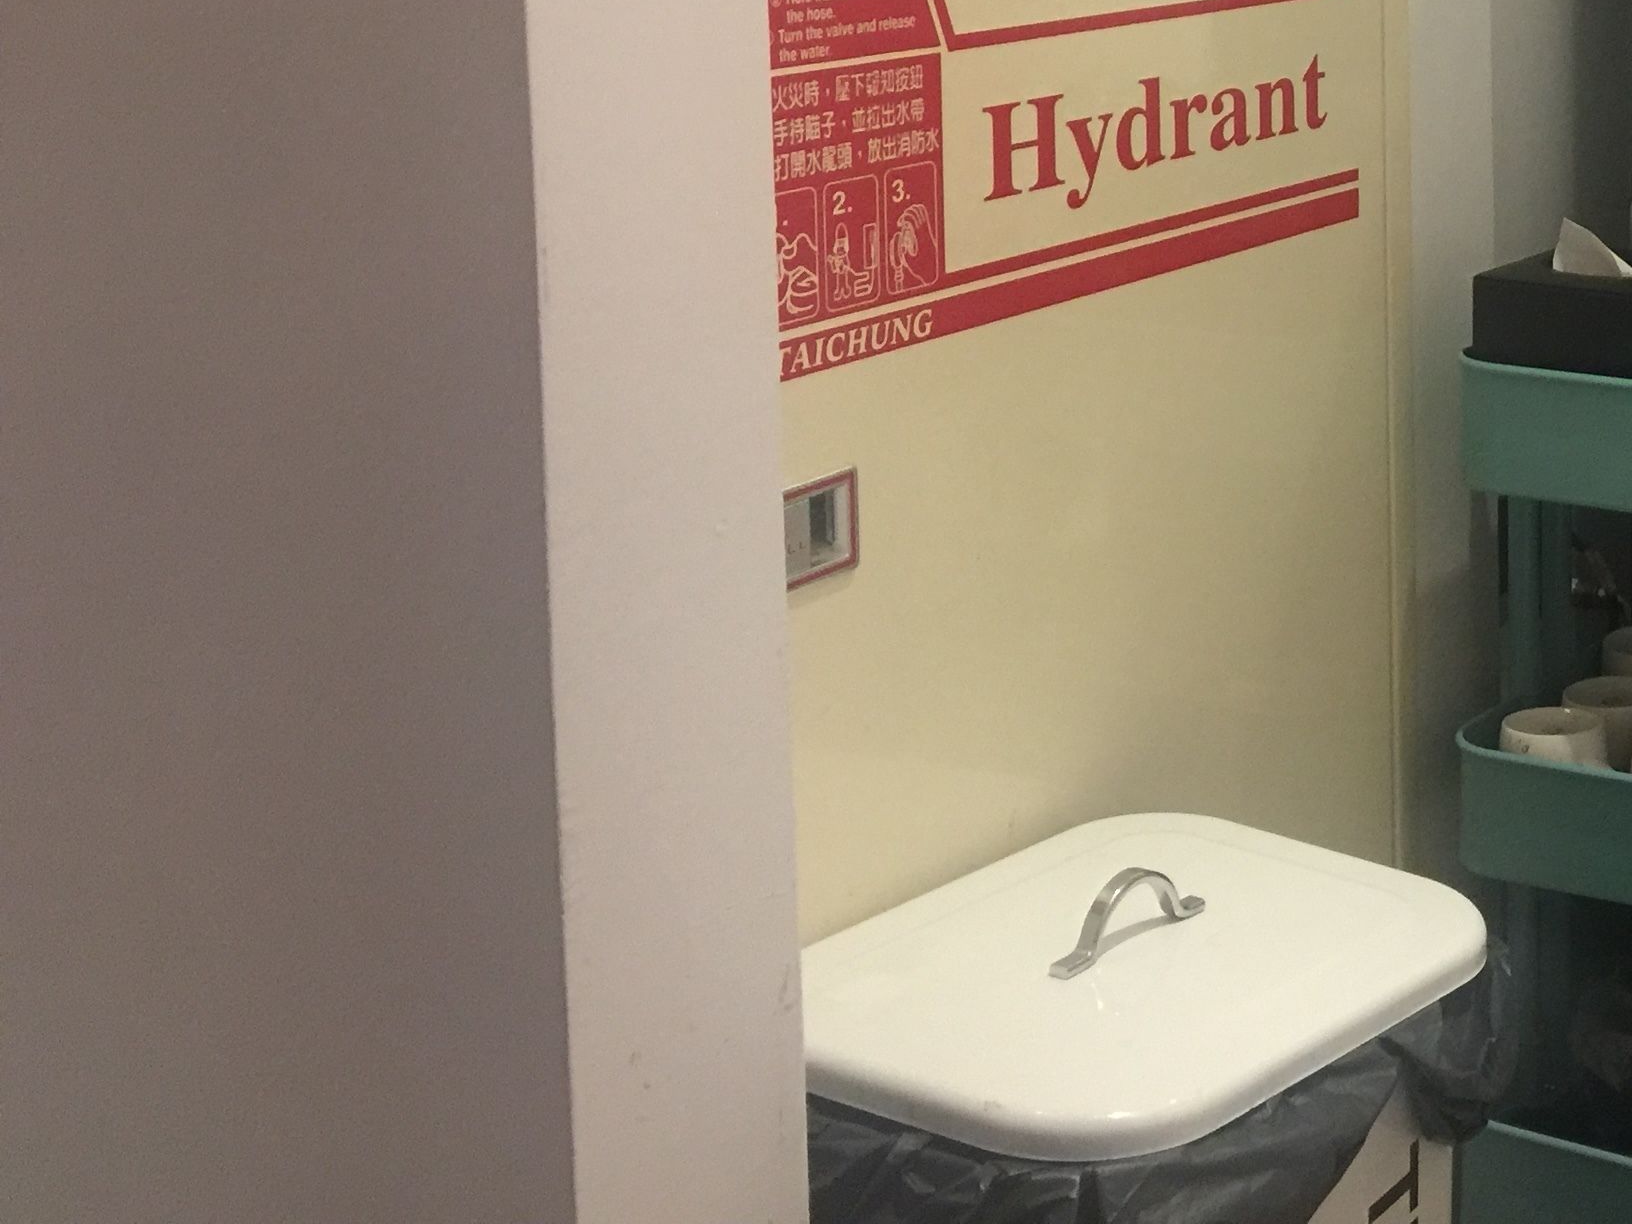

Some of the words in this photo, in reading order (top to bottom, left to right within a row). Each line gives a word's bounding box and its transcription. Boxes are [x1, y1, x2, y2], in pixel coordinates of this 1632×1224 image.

[786, 8, 804, 24] the
[806, 6, 836, 21] hose.
[778, 28, 803, 44] Turn
[805, 25, 823, 40] the
[825, 21, 854, 37] valve
[856, 18, 876, 34] and
[878, 16, 916, 30] release
[779, 47, 797, 63] the
[982, 54, 1328, 210] Hydrant
[892, 179, 911, 203] 3.
[832, 191, 853, 216] 2.
